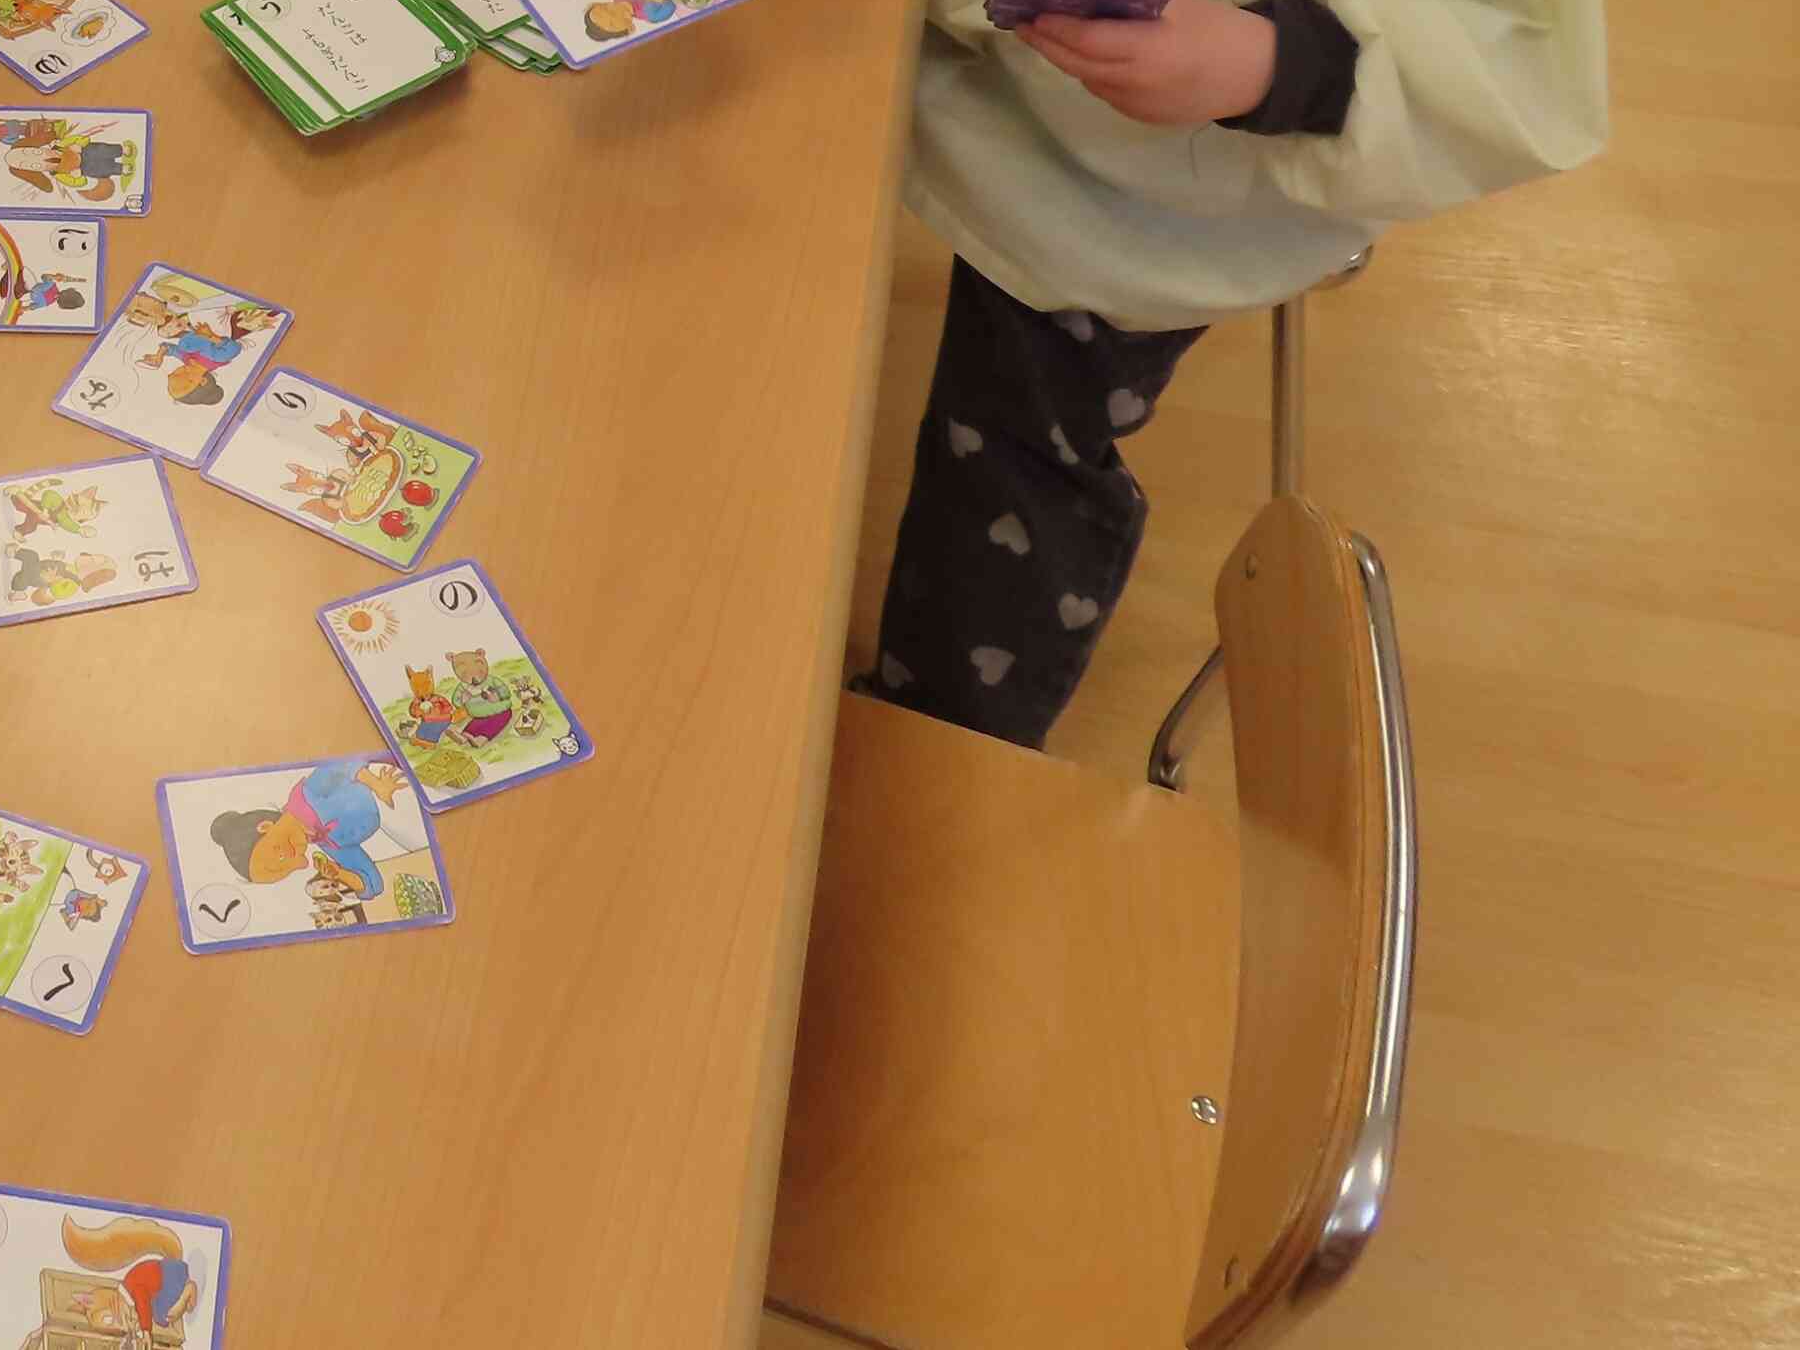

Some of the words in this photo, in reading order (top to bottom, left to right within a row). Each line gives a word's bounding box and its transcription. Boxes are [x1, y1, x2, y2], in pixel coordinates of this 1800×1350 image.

[34, 54, 68, 76] ゆ
[59, 229, 88, 250] に
[80, 378, 114, 411] な
[274, 393, 306, 408] り
[134, 552, 174, 581] は
[439, 581, 478, 610] の
[199, 900, 240, 922] く
[44, 964, 74, 1001] へ
